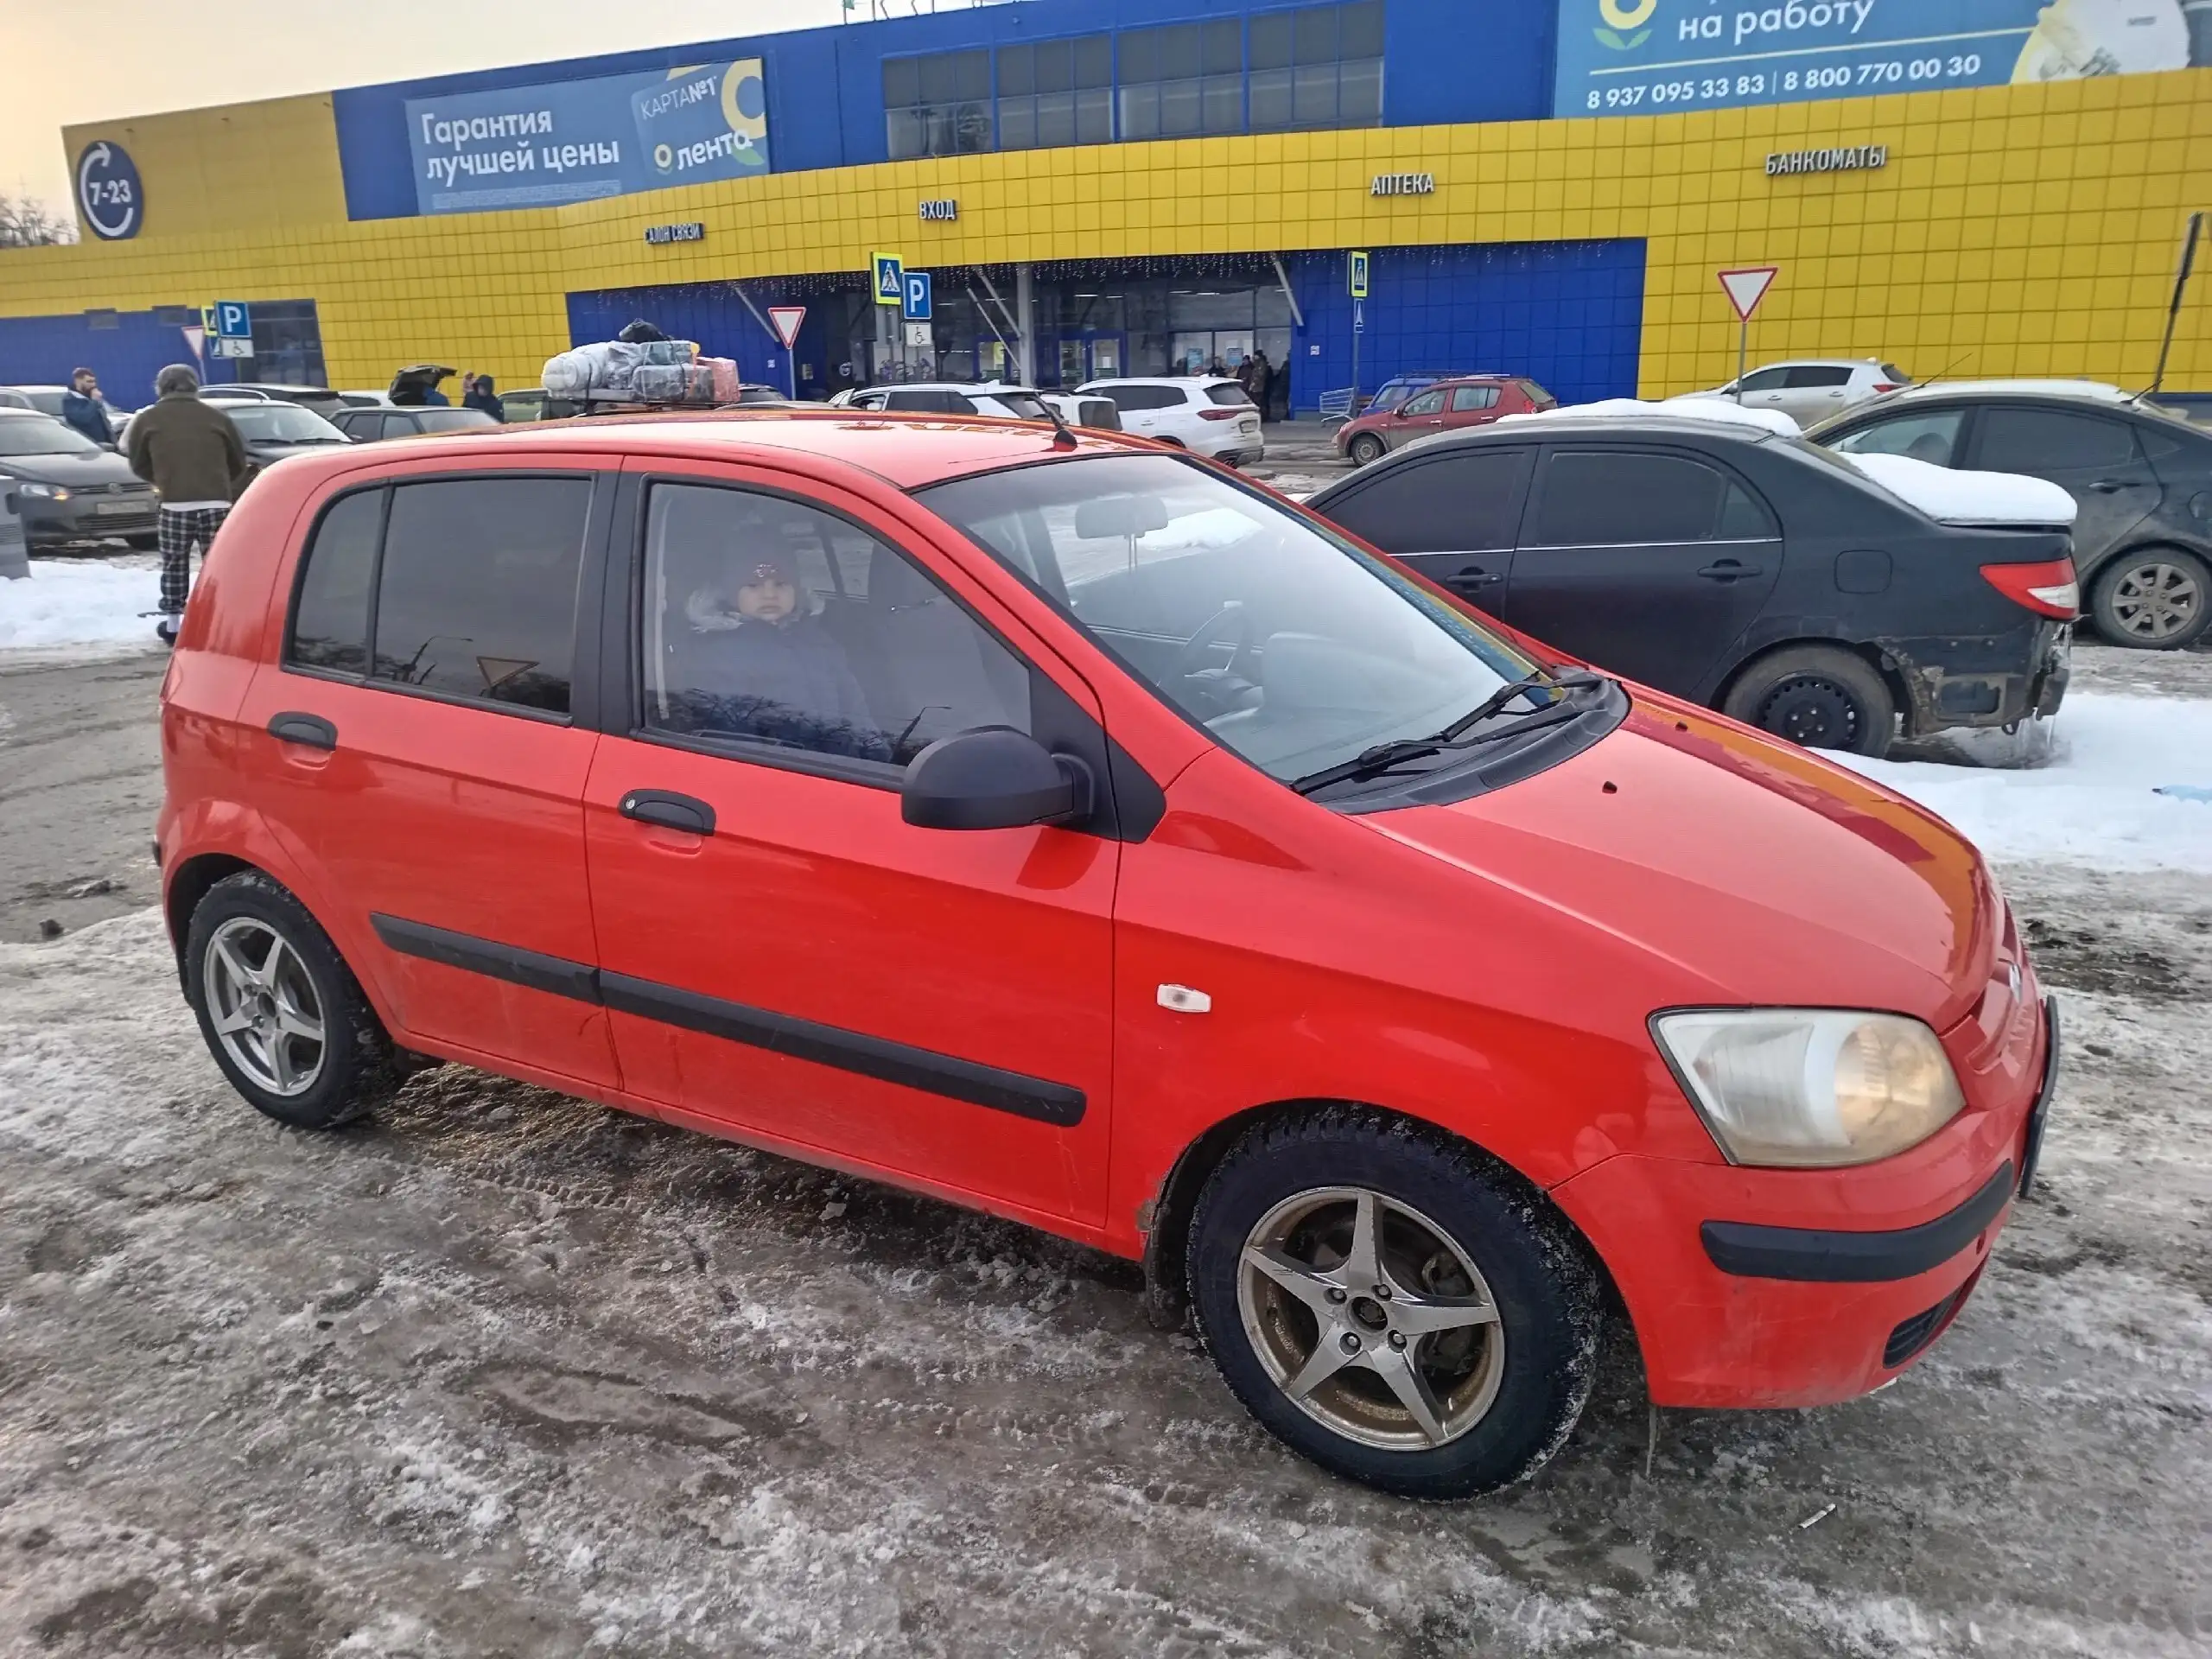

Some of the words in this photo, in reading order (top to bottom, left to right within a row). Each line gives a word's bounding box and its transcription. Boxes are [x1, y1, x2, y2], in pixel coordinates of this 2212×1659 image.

[1679, 15, 1722, 41] на
[1734, 0, 1875, 46] работу
[1586, 91, 1599, 109] 8
[1605, 86, 1646, 106] 937
[1651, 80, 1694, 103] 095
[1700, 78, 1729, 99] 33
[1735, 74, 1765, 94] 83
[1783, 70, 1798, 90] 8
[1804, 66, 1852, 87] 800
[1856, 60, 1904, 84] 770
[1908, 56, 1942, 79] 00
[1947, 54, 1982, 76] 30
[421, 110, 553, 151] Гарантия
[426, 141, 535, 188] лучшей
[542, 141, 620, 174] цены
[677, 129, 753, 171] лента
[1765, 144, 1887, 175] БАНКОМАТЫ
[89, 179, 132, 206] 7-23
[1370, 172, 1434, 195] АПТЕКА
[918, 200, 957, 221] ВХОД
[672, 221, 703, 242] СВЯЗИ
[909, 278, 925, 314] P
[223, 305, 242, 333] P
